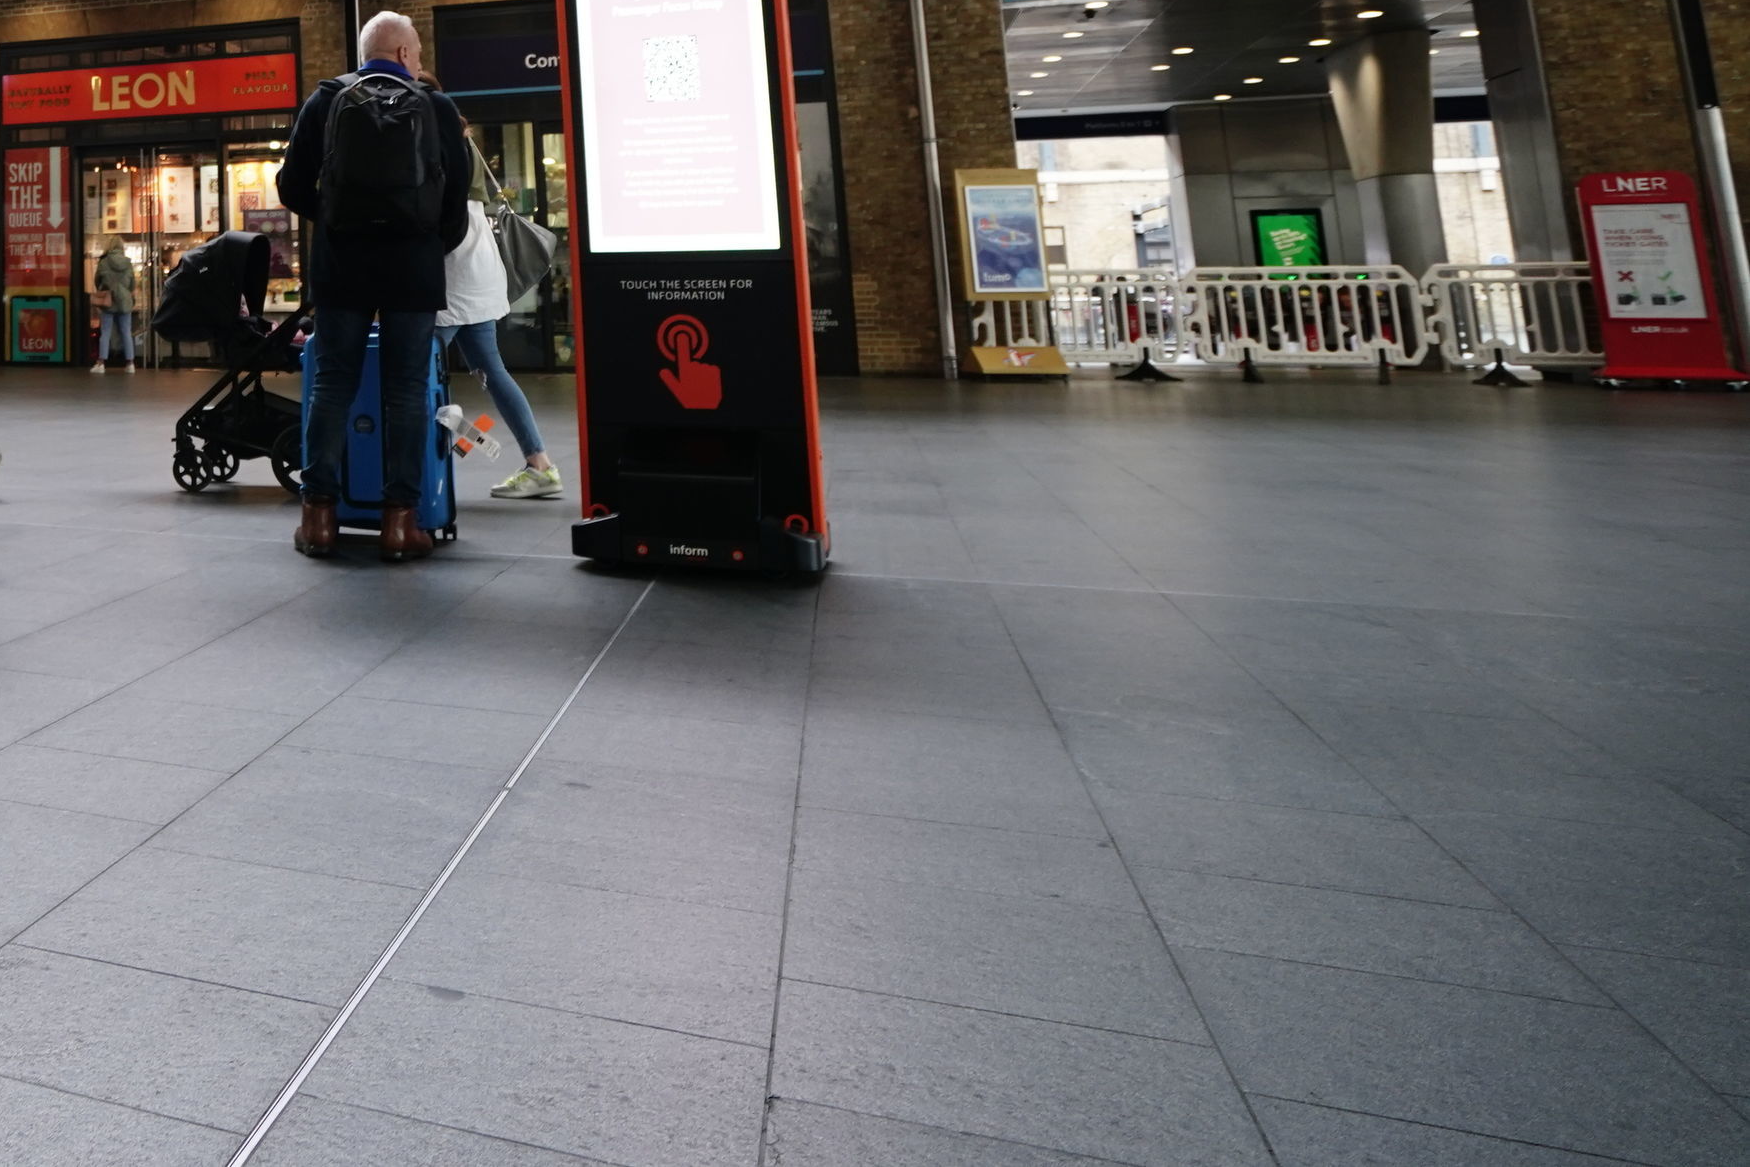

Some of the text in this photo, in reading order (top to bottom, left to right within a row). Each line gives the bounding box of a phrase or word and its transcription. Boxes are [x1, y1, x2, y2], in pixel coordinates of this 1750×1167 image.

[525, 53, 560, 69] Con
[90, 69, 196, 112] LEON
[233, 82, 290, 96] FLAVOUR
[9, 161, 43, 184] SKIP
[1601, 176, 1668, 193] LNER
[9, 184, 43, 210] THE
[9, 211, 43, 228] QUEUE
[620, 279, 753, 290] TOUCH THE SCREEN FOR
[647, 290, 725, 301] INFORMATION
[22, 337, 54, 351] LEON
[669, 543, 709, 557] inform
